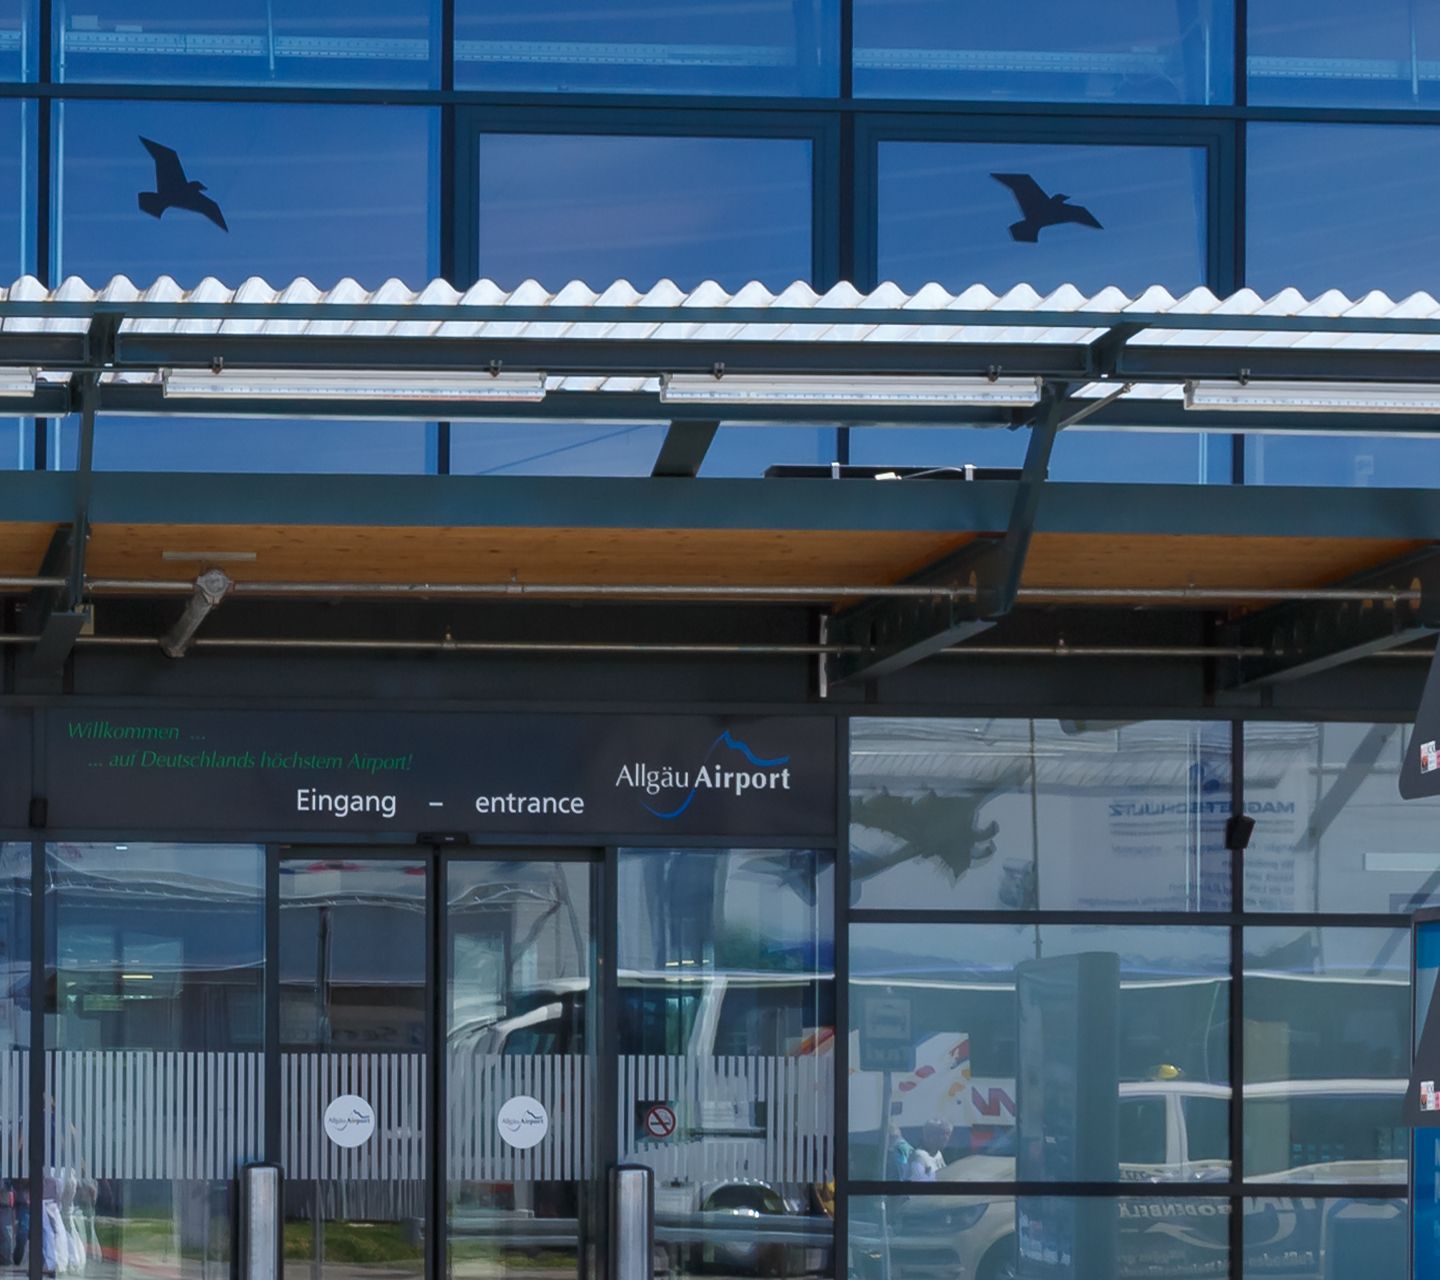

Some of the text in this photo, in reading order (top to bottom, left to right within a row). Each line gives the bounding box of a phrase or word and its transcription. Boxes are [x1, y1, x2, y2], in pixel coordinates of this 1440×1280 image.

[68, 721, 181, 741] Willkommen
[141, 750, 257, 769] Deutschlands
[260, 751, 344, 770] höchstem
[348, 752, 413, 775] Airport!
[615, 763, 791, 796] Allgäu Airport
[297, 788, 397, 818] Eingang
[475, 793, 585, 815] entrance
